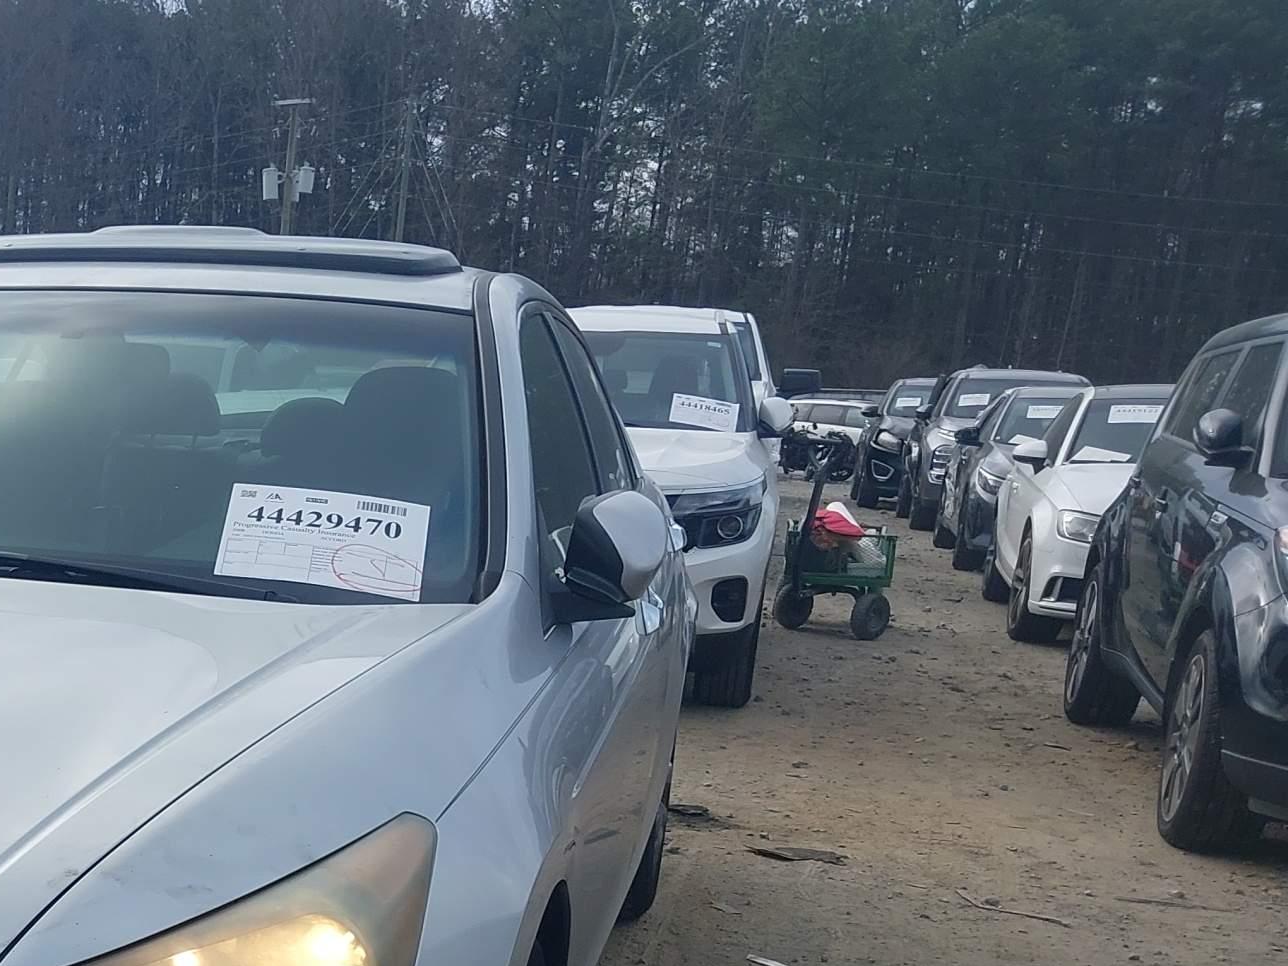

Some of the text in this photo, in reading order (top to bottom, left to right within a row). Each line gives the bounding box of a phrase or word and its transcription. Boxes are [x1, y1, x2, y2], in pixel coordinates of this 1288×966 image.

[233, 520, 280, 531] Progressive
[280, 525, 316, 535] Casualty
[317, 528, 357, 539] Insurance
[247, 505, 402, 539] 44429470
